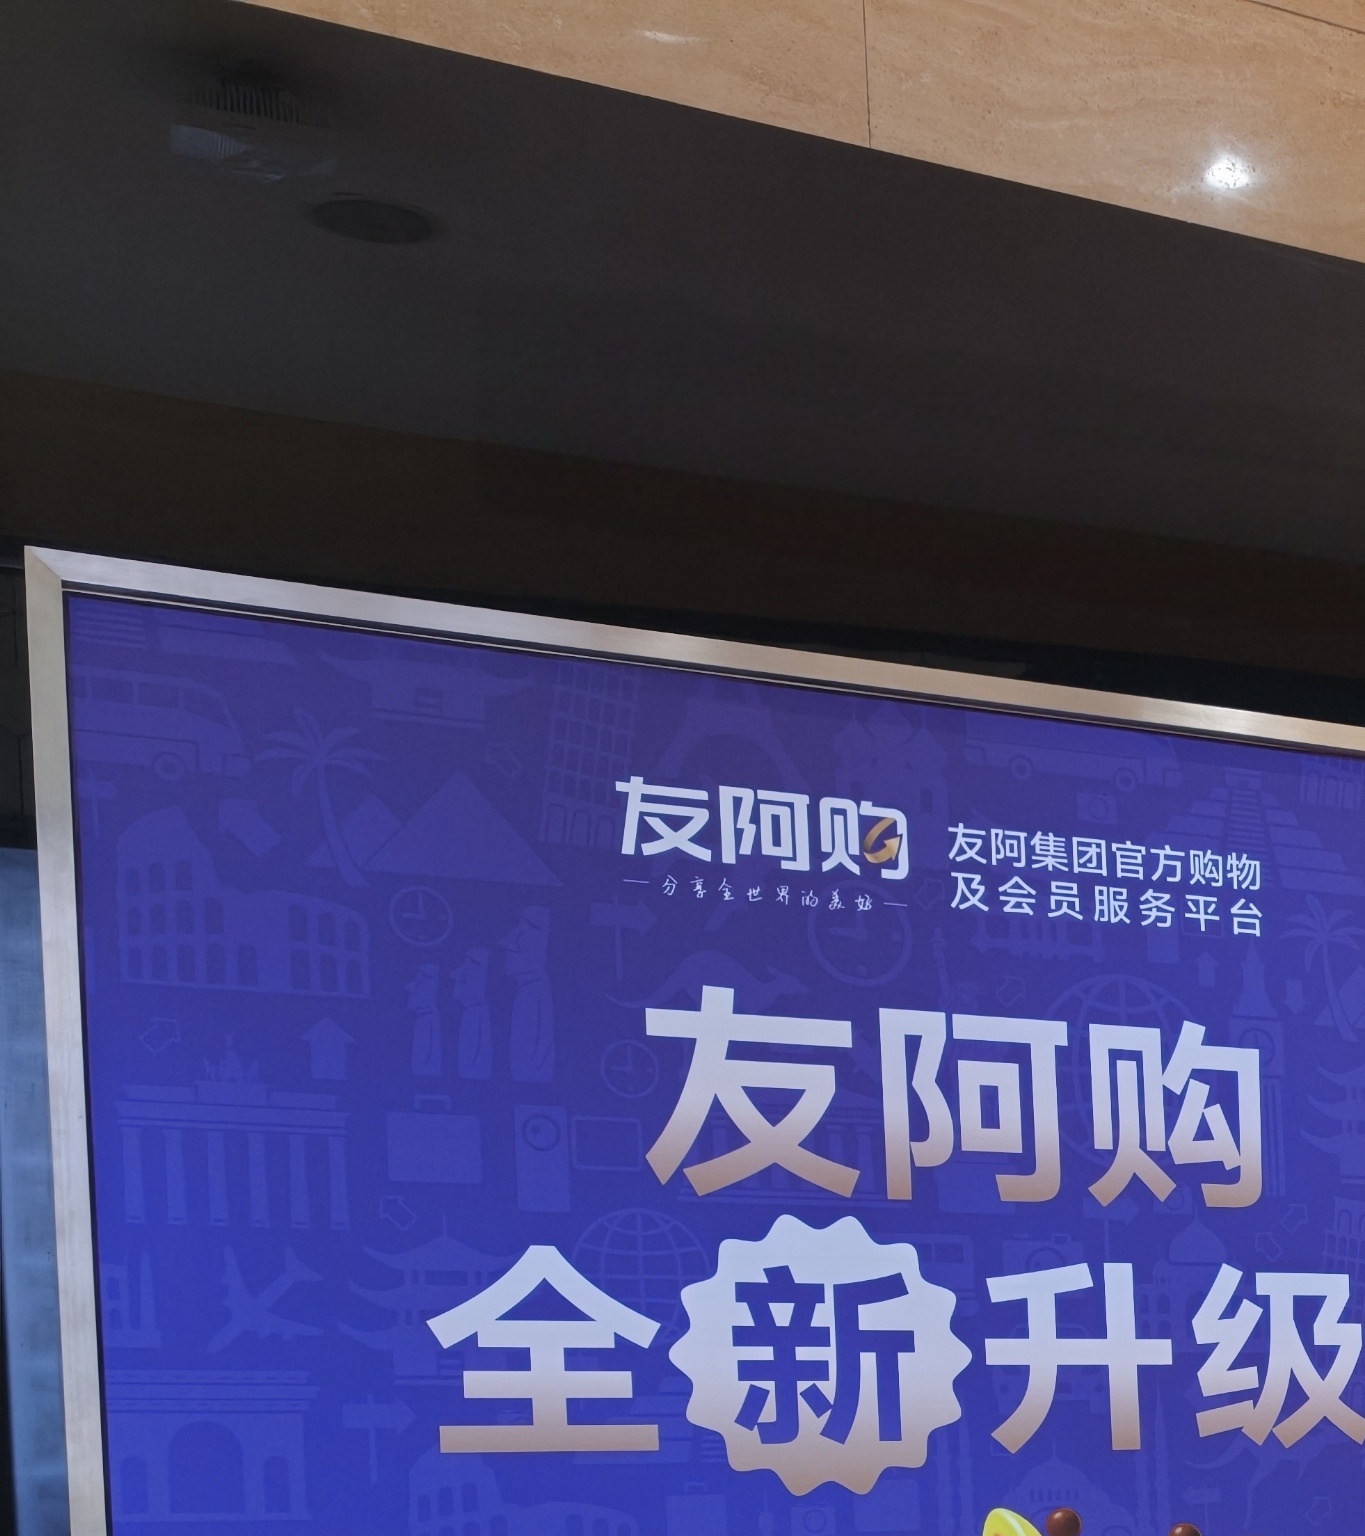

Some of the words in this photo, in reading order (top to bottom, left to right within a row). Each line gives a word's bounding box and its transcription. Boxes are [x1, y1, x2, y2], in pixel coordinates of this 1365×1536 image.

[615, 776, 909, 880] 友阿购
[946, 821, 1262, 893] 友阿集团官方购物
[949, 871, 1263, 938] 及会员服务平台
[643, 984, 1264, 1209] 友阿购
